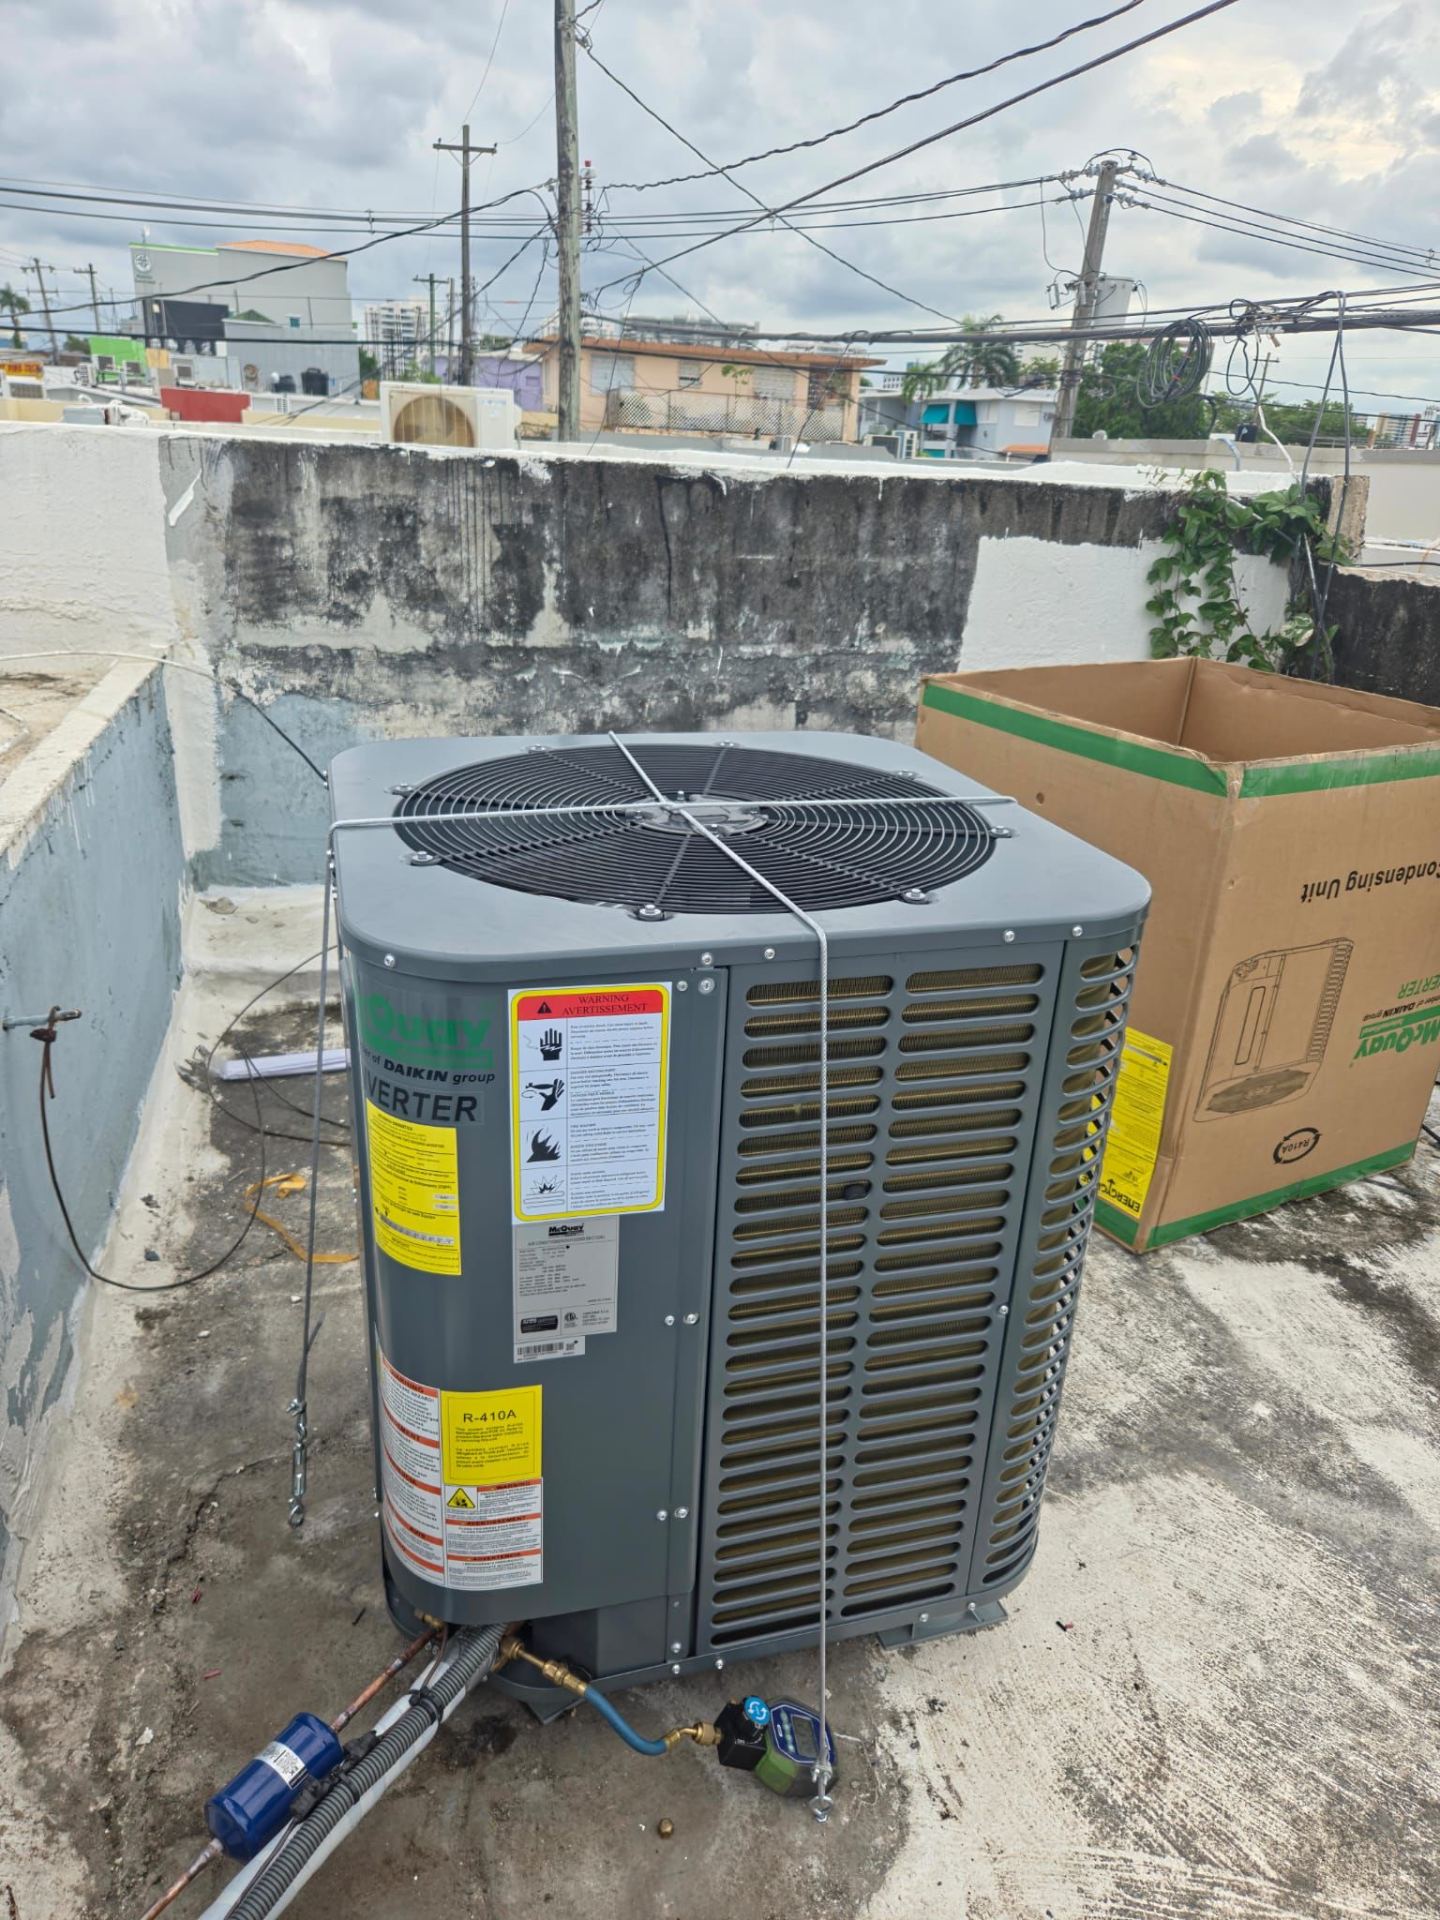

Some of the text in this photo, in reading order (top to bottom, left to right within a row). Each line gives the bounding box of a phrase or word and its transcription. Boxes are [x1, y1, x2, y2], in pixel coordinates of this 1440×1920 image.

[1300, 878, 1340, 903] Unit
[1397, 974, 1440, 999] ERTER
[563, 1002, 648, 1016] AVERTISSEMENT
[578, 993, 629, 1004] WARNING
[366, 992, 493, 1047] Quay
[1382, 1002, 1416, 1018] DAIKIN
[1353, 1018, 1440, 1060] McQuay
[383, 1058, 449, 1083] DAIKIN
[452, 1073, 496, 1086] group
[367, 1069, 478, 1123] VERTER
[1281, 1138, 1311, 1155] R410A
[548, 1225, 584, 1233] McQuay
[463, 1409, 517, 1423] R-410A
